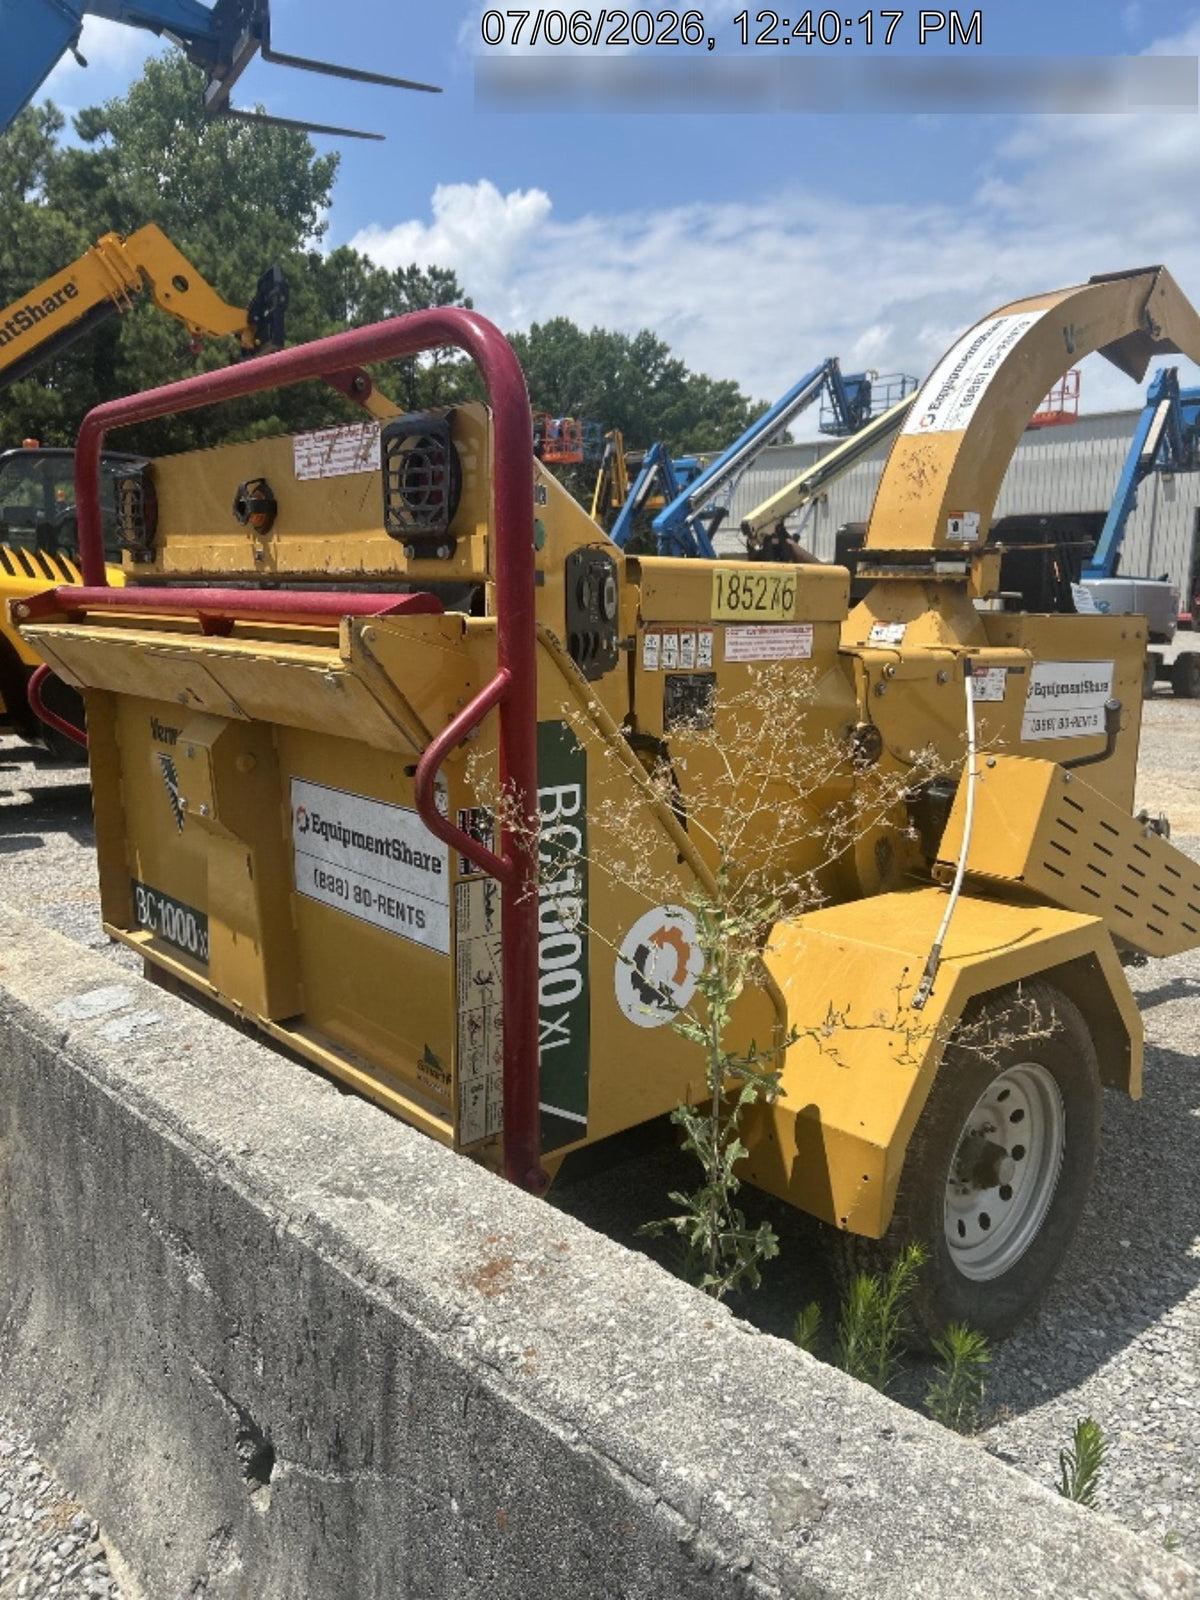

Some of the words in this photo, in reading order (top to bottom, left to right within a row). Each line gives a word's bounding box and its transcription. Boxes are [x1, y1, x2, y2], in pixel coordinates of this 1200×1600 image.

[716, 574, 794, 613] 185276
[150, 715, 183, 746] Verm
[311, 812, 442, 875] EquipmentShare
[353, 884, 426, 930] 80-RENTS
